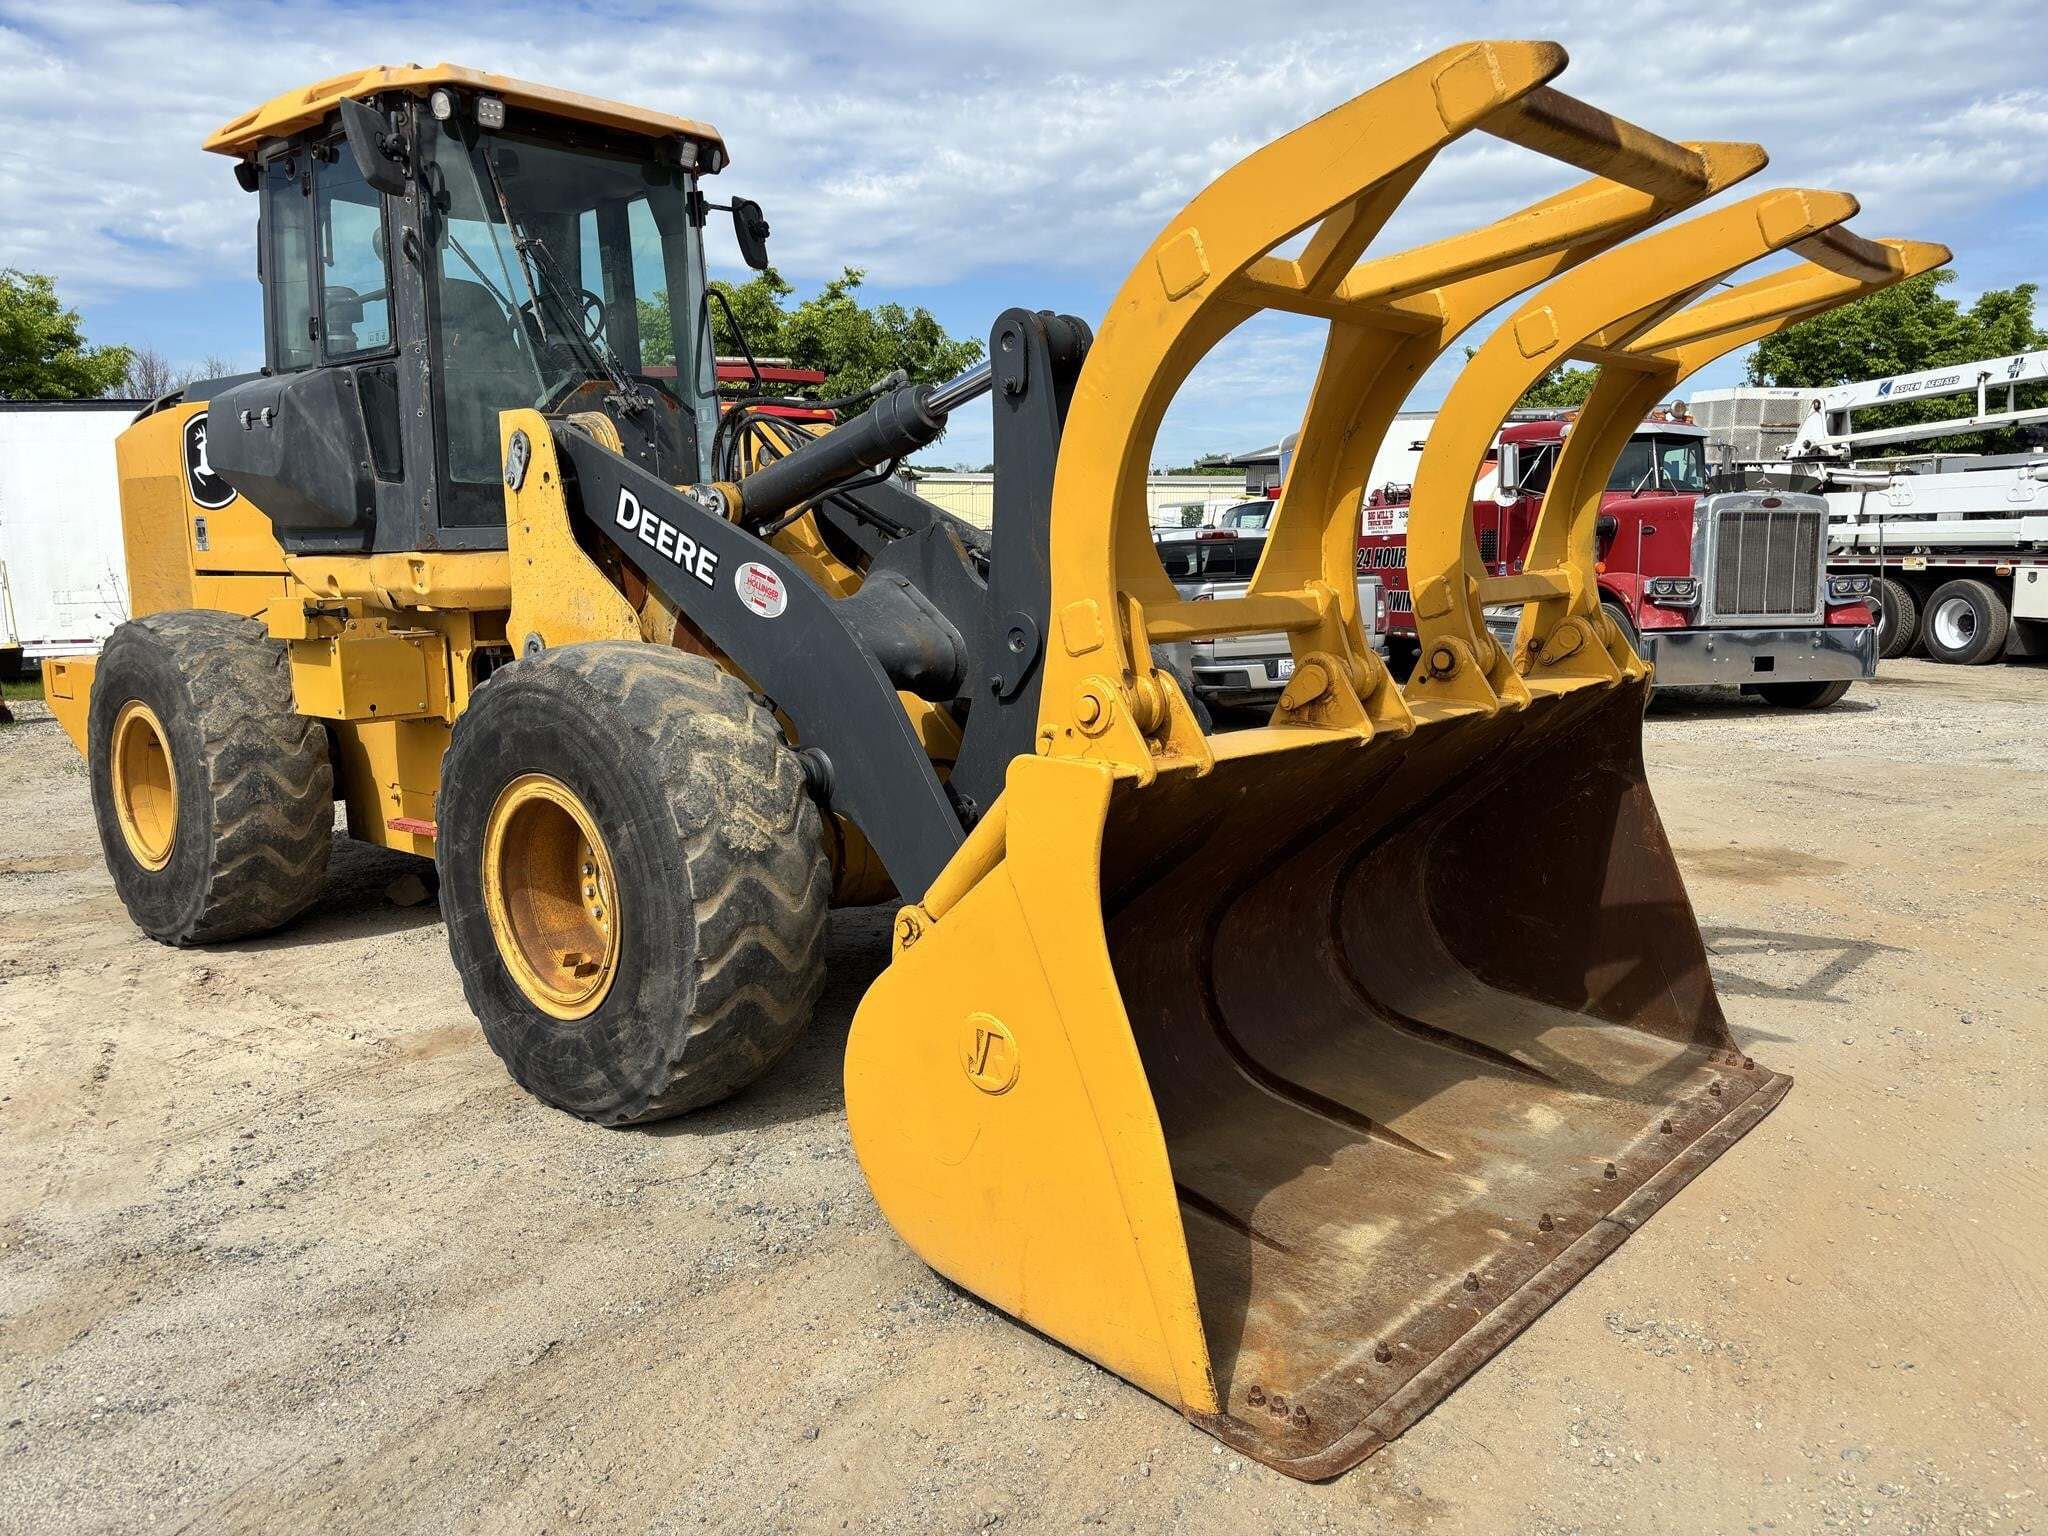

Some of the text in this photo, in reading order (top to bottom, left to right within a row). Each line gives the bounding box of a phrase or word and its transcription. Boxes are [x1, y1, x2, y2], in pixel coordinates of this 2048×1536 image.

[1893, 375, 1960, 394] ASPEN AERIALS
[1368, 511, 1376, 520] BIG
[615, 486, 719, 588] DEERE
[1357, 547, 1372, 569] 24
